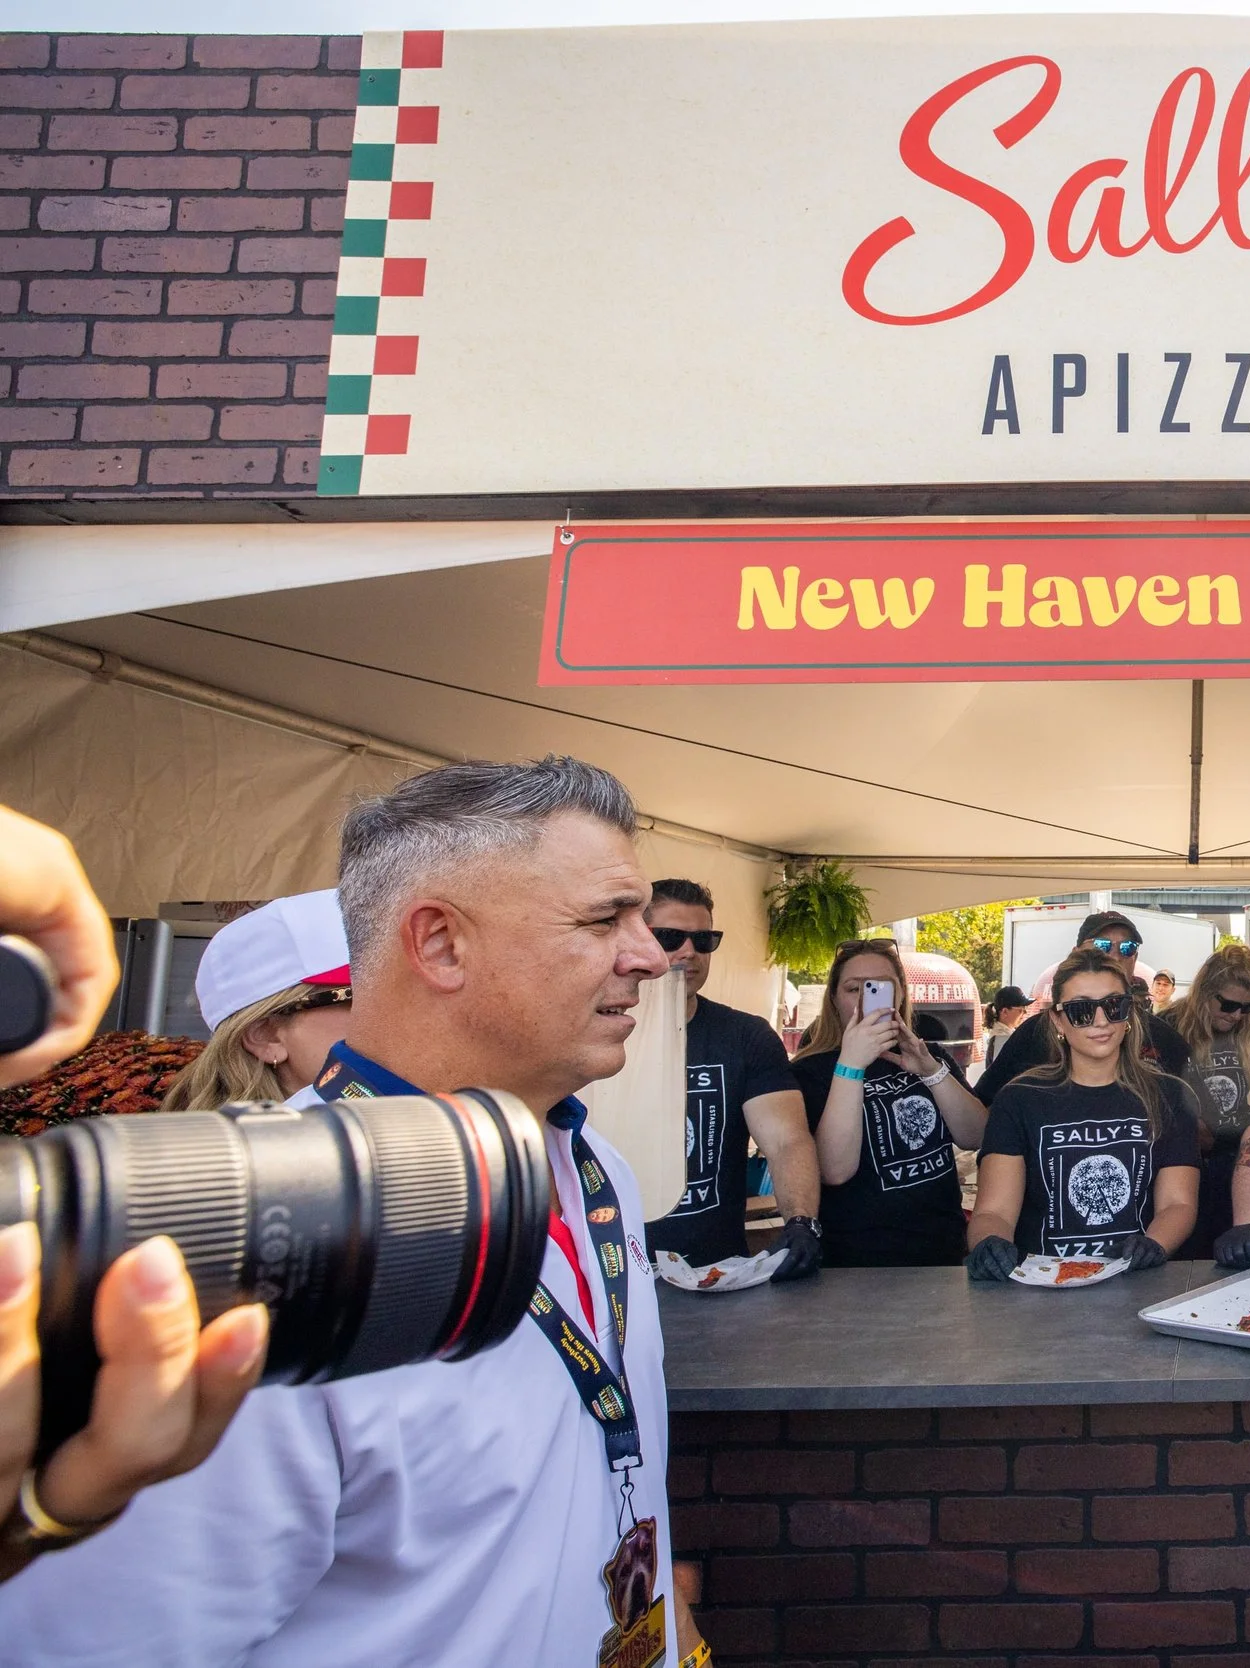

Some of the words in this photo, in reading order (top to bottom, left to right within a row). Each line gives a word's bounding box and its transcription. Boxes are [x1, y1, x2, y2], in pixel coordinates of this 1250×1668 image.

[738, 565, 934, 630] New
[963, 564, 1242, 628] Haven
[707, 1105, 716, 1147] ESTABLISHED
[1052, 1125, 1143, 1144] SALLY'S
[1134, 1154, 1146, 1197] ESTABLISHED
[560, 1337, 589, 1371] Everybody
[573, 1339, 585, 1351] the
[583, 1348, 601, 1375] Knows
